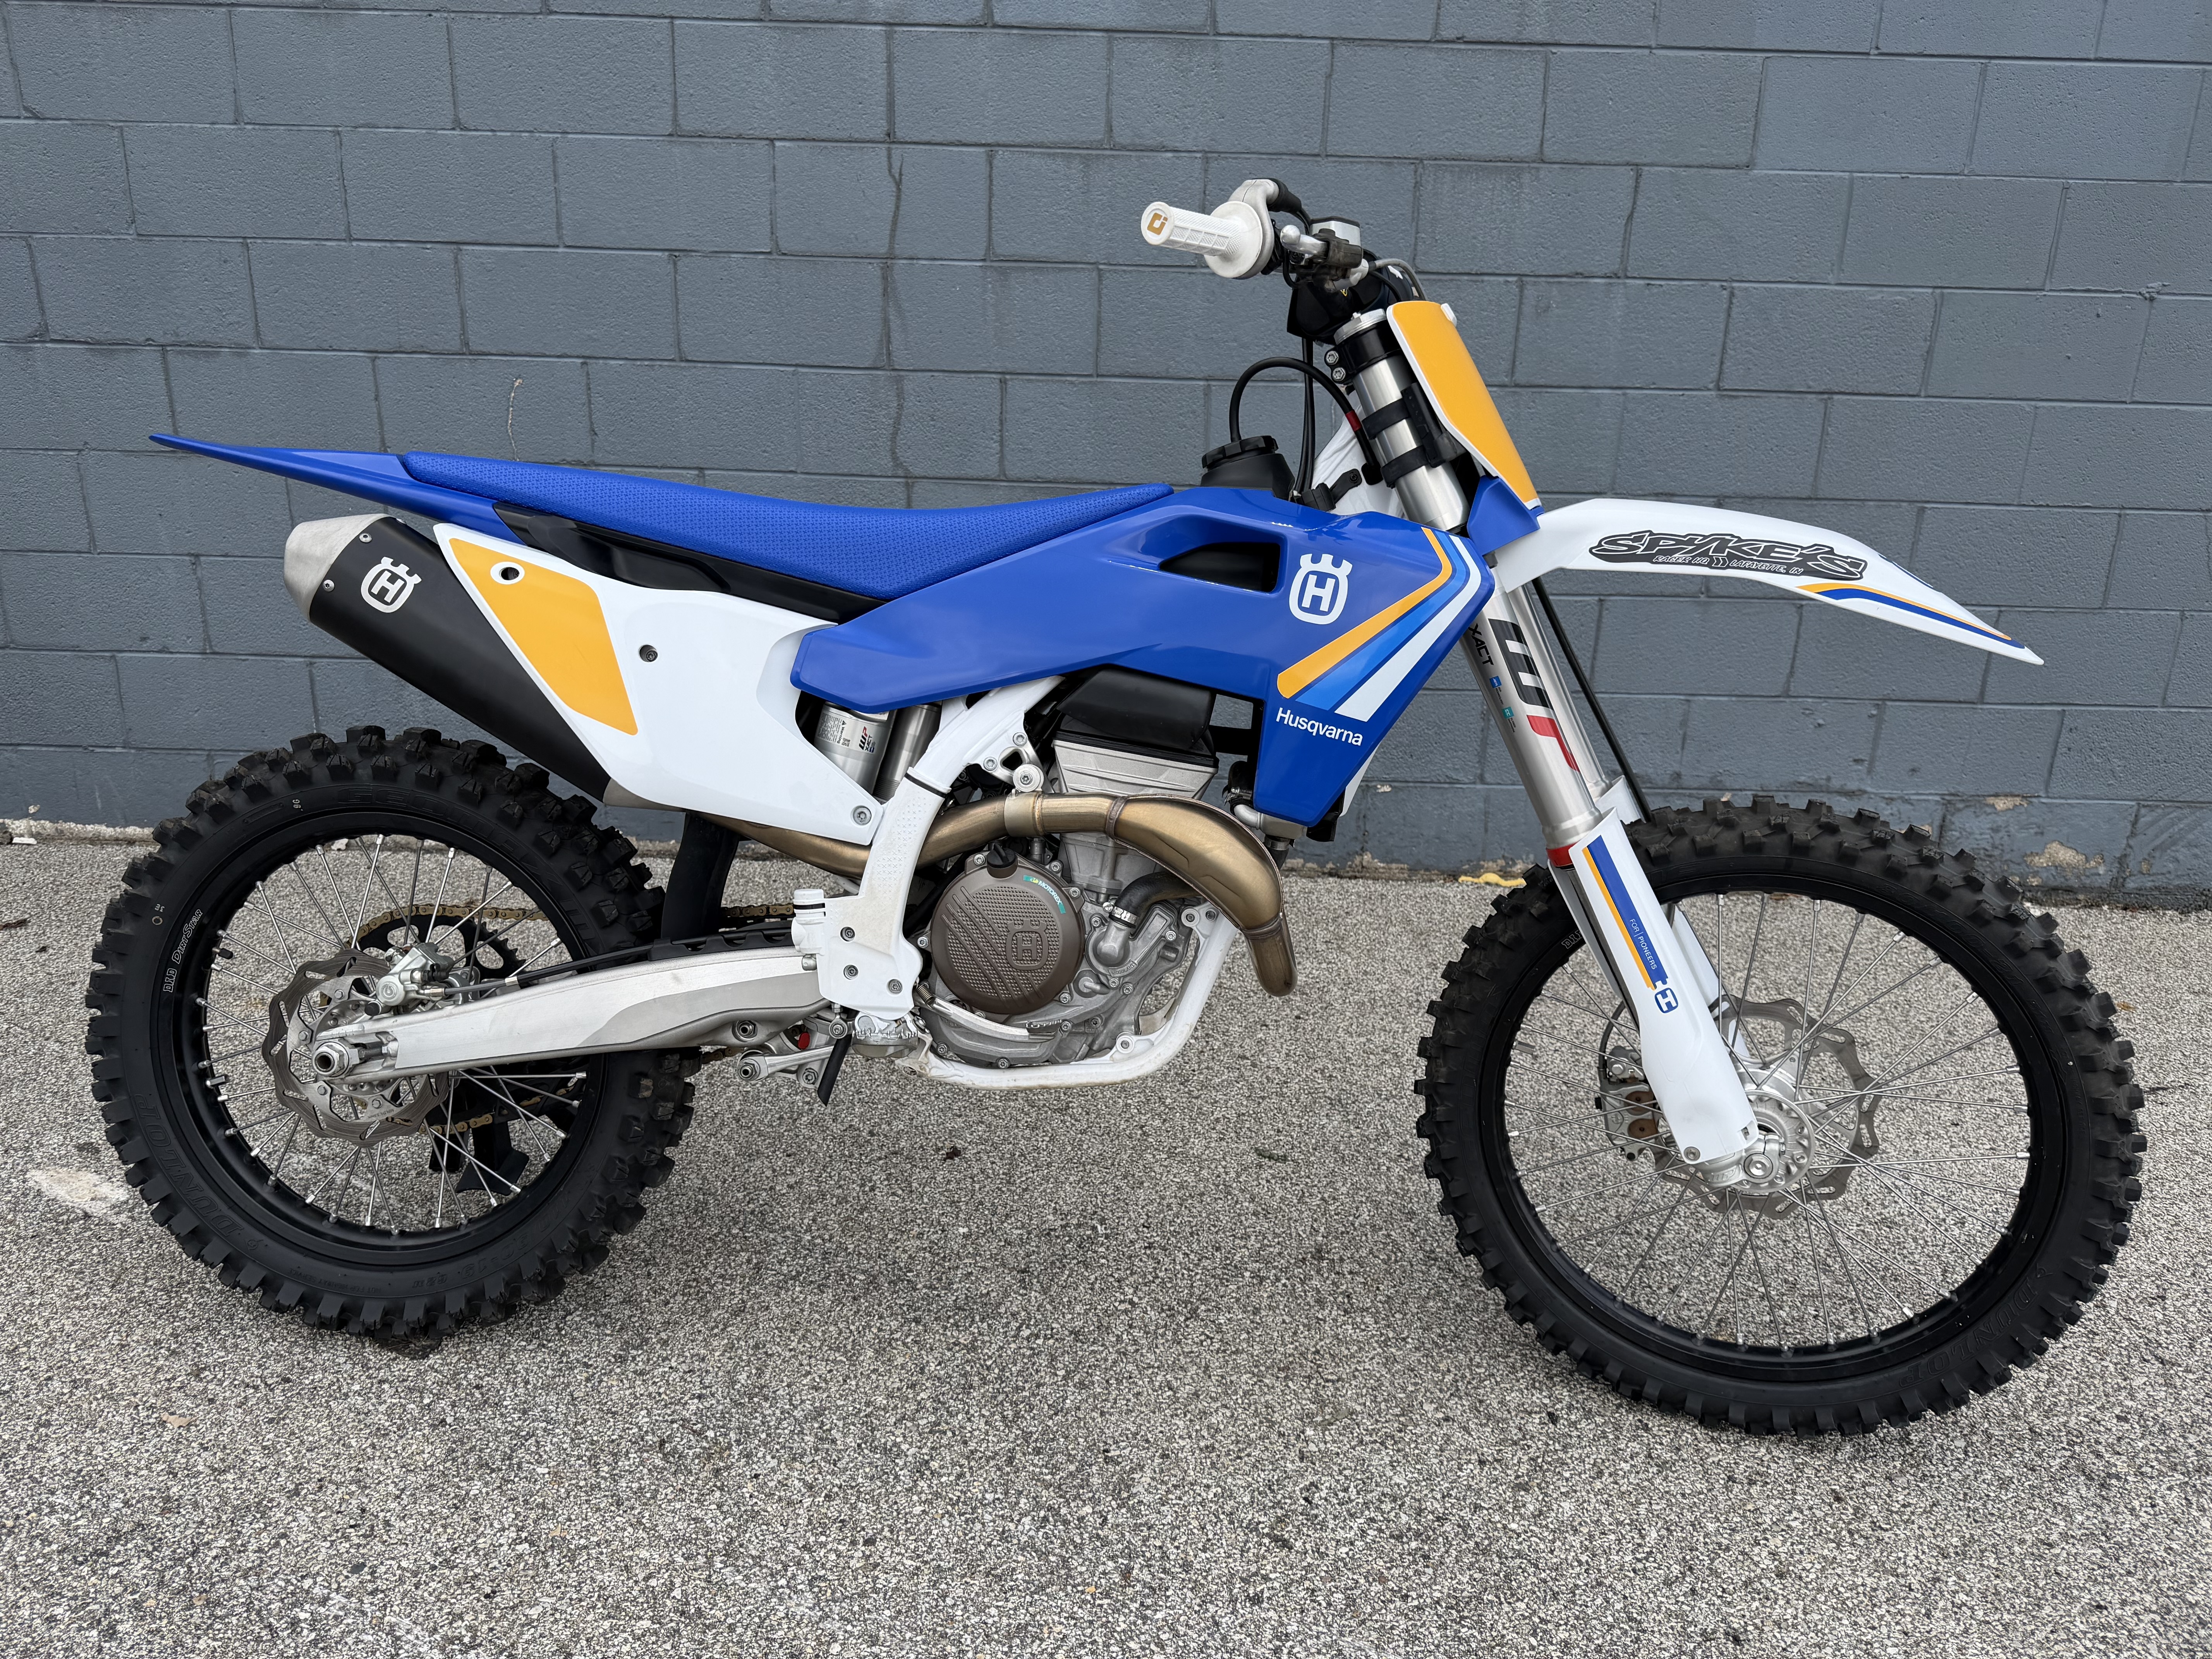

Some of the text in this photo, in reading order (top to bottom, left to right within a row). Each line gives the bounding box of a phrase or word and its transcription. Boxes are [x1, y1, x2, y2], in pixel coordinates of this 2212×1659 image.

[1592, 531, 1864, 578] SPYKE'S
[1653, 555, 1692, 563] RACER
[1468, 623, 1494, 666] XACT
[1276, 707, 1363, 746] Husqvarna
[1038, 880, 1063, 905] MOTOREX
[1630, 918, 1657, 970] FOR PIONEERS
[134, 1094, 245, 1237] DUNLOP
[1899, 1276, 2038, 1388] DUNLOP
